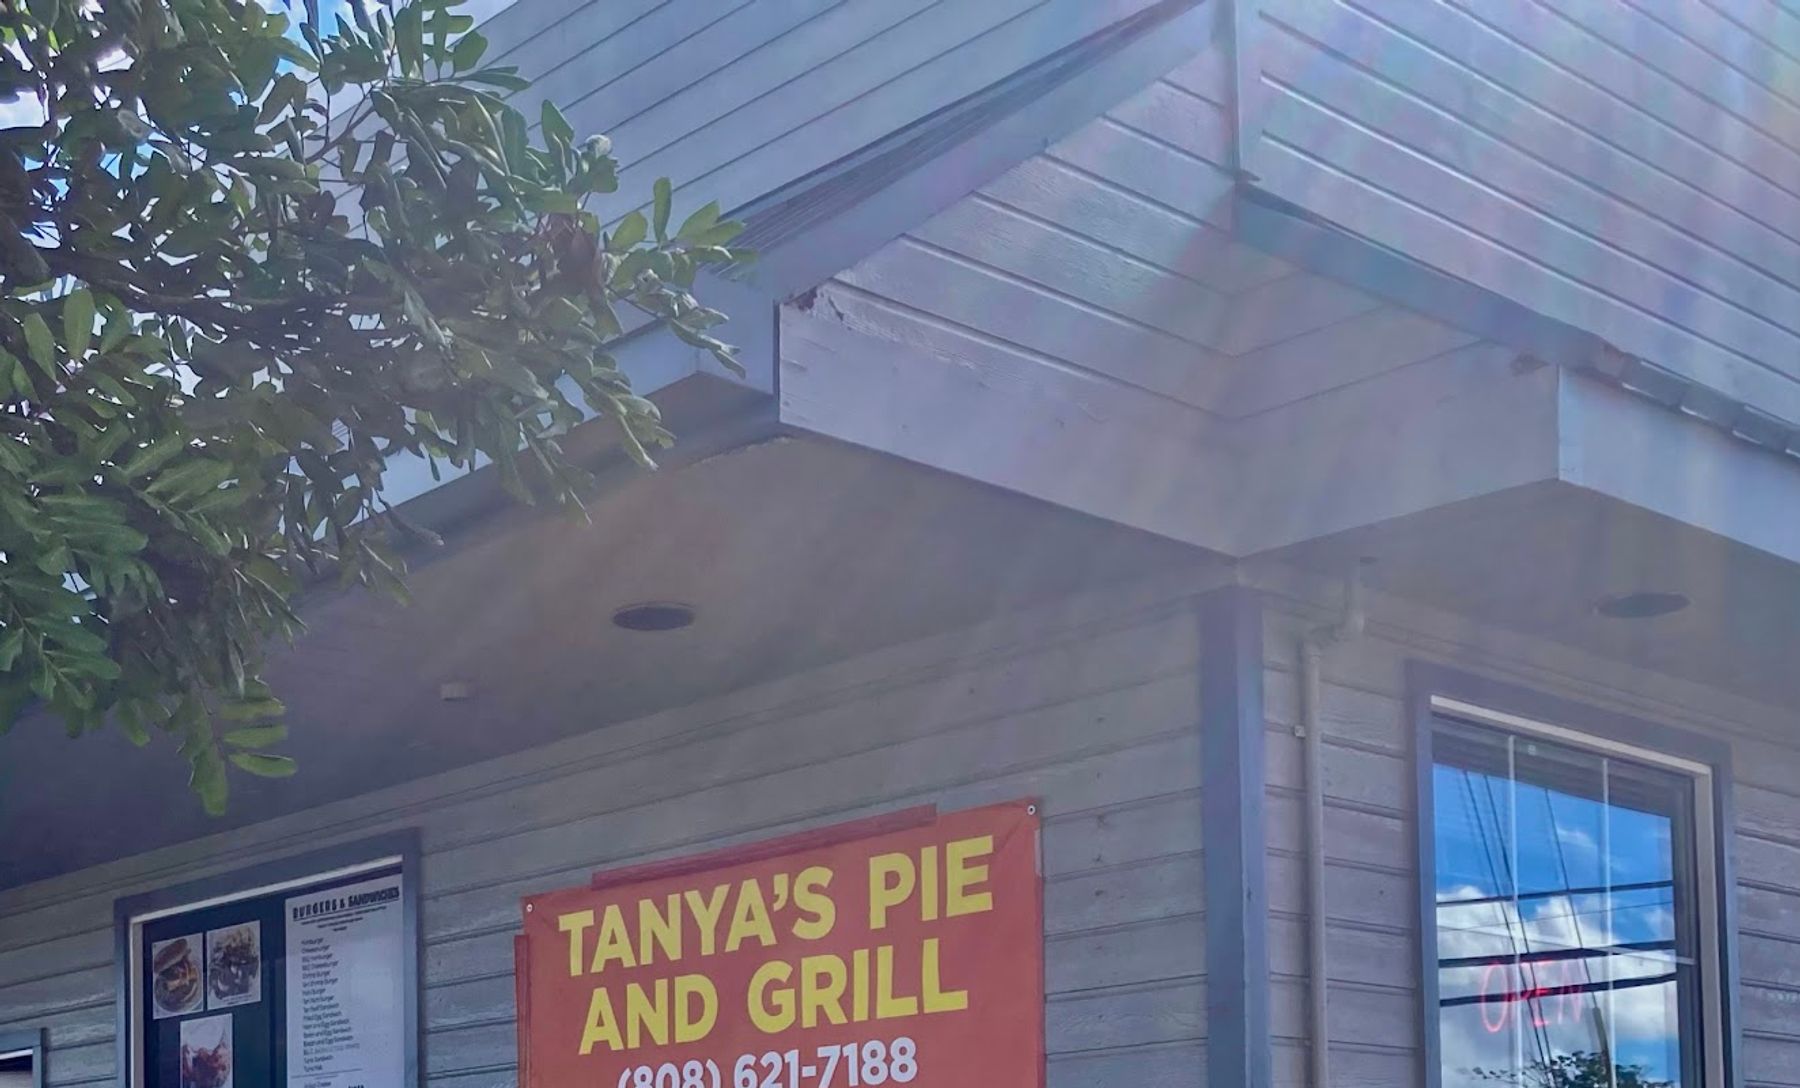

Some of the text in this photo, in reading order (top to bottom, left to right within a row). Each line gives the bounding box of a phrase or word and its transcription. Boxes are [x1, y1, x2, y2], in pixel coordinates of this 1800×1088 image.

[559, 834, 993, 976] TANYA'S PIE
[578, 938, 968, 1055] AND GRILL
